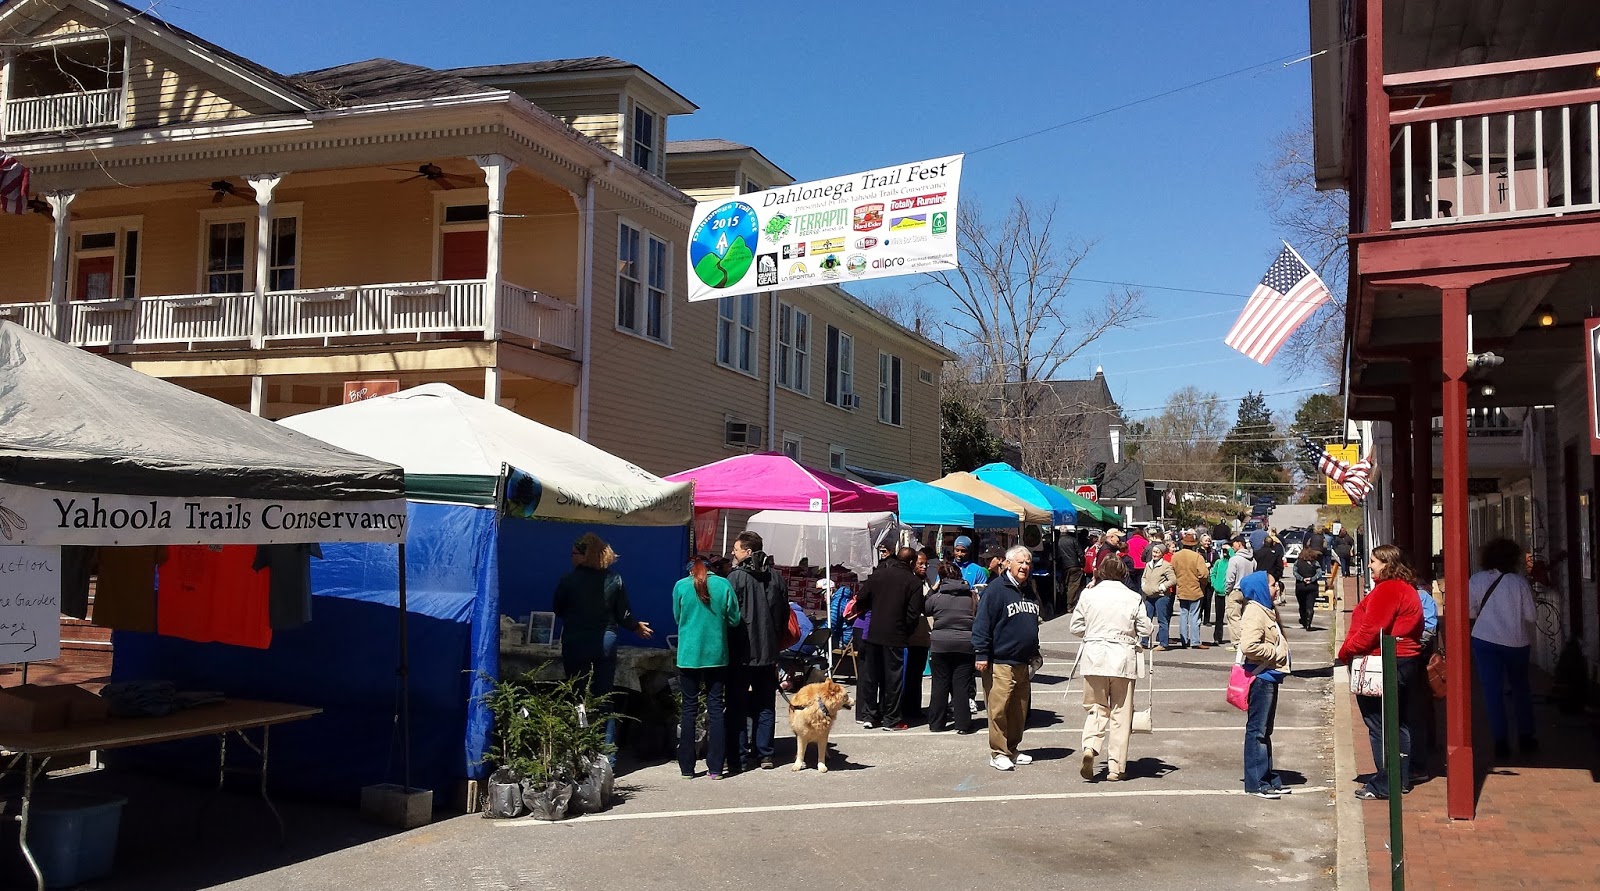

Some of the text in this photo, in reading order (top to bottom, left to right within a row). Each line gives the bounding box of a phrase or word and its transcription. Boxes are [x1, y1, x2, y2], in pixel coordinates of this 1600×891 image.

[762, 162, 948, 208] Dahlonega Trail Fest
[880, 187, 899, 198] Trails
[901, 181, 947, 194] Conservancy
[734, 202, 752, 215] Trail
[891, 198, 915, 210] Totally
[916, 194, 947, 206] Running
[711, 215, 740, 231] 2015
[794, 206, 849, 234] TERRAPIN
[854, 220, 882, 230] Hard Cider
[872, 256, 905, 269] allpro
[758, 276, 778, 285] GEAR
[53, 497, 407, 538] Yahoola Trails Conservancy
[1006, 601, 1040, 618] EMORY
